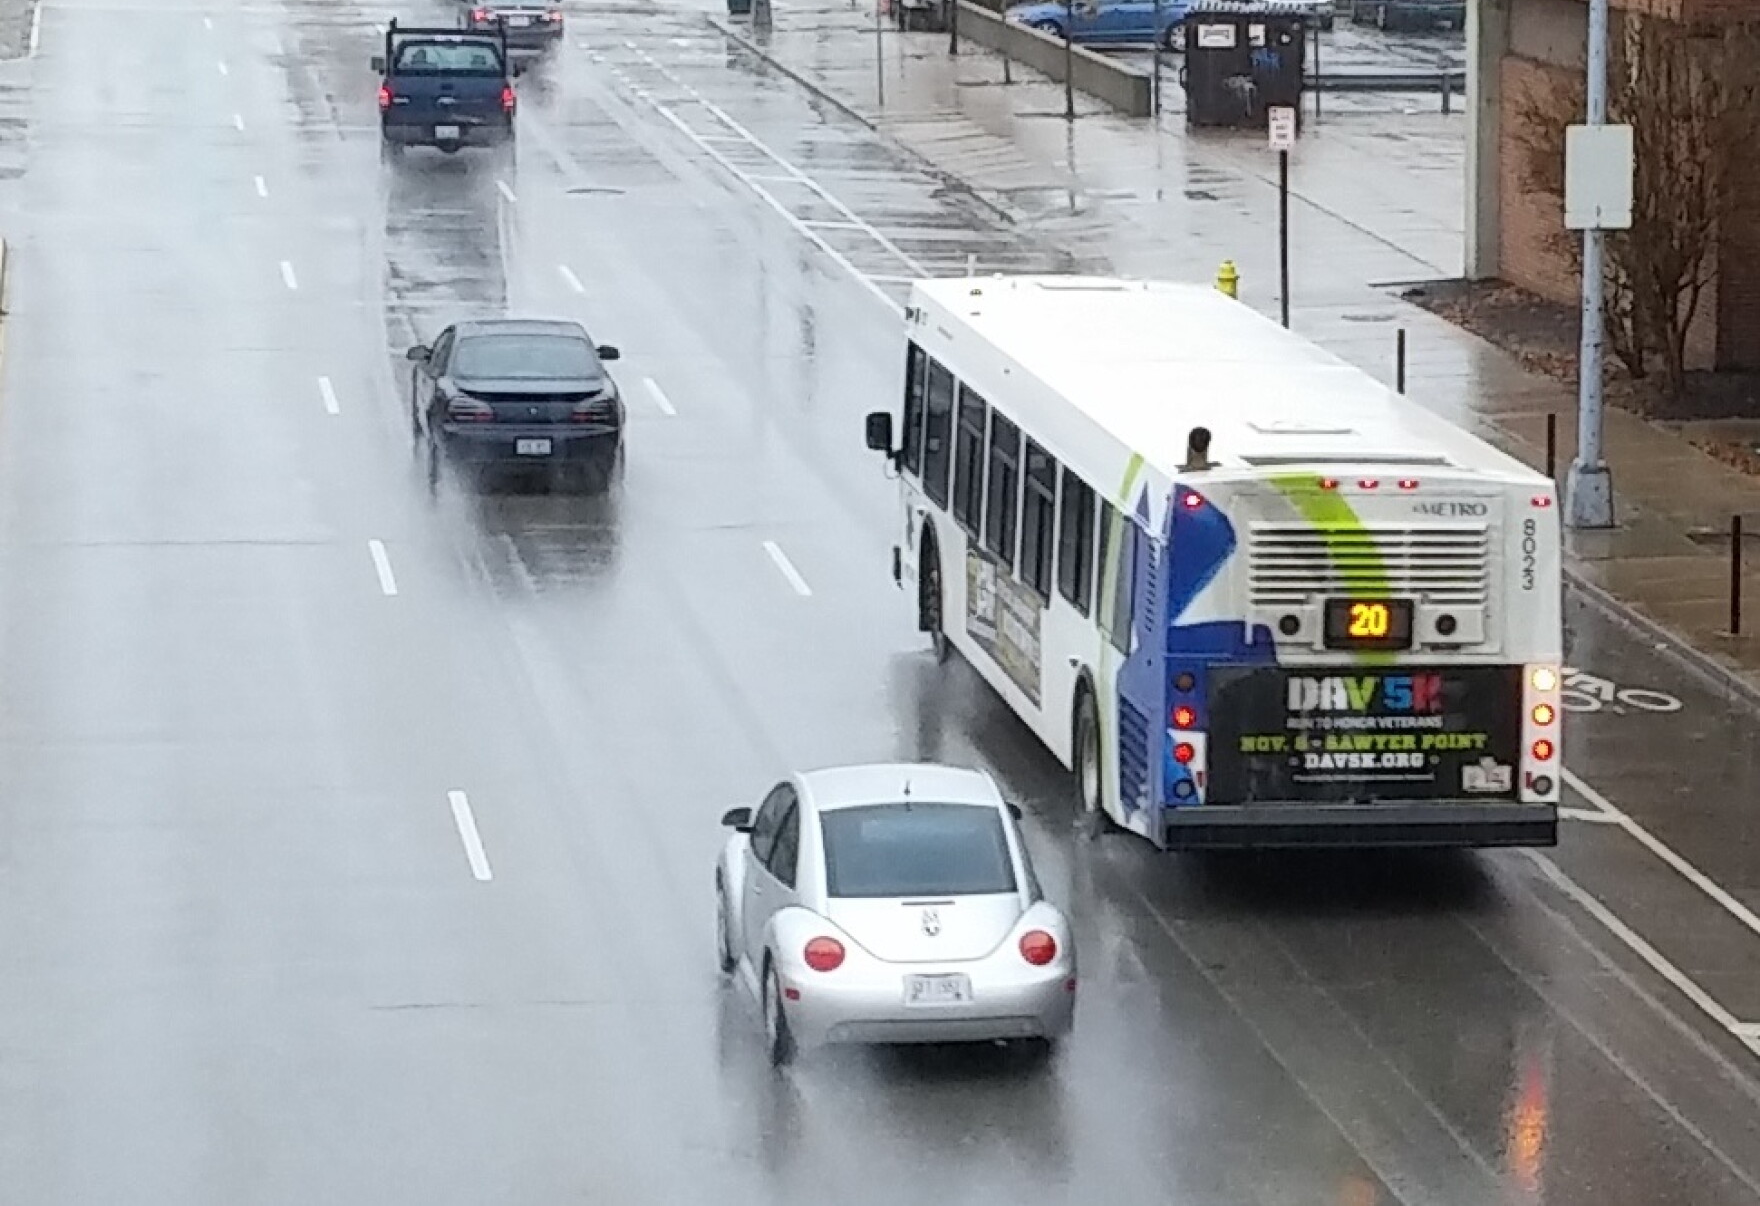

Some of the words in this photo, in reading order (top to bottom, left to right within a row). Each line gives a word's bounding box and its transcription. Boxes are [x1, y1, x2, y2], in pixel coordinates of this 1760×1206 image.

[1420, 502, 1488, 516] METRO
[1522, 518, 1536, 590] 8023
[1350, 603, 1388, 636] 20
[1287, 676, 1380, 711] DAV
[1240, 736, 1289, 752] NOV.
[1325, 734, 1416, 750] SAWYER
[1421, 733, 1488, 750] POINT
